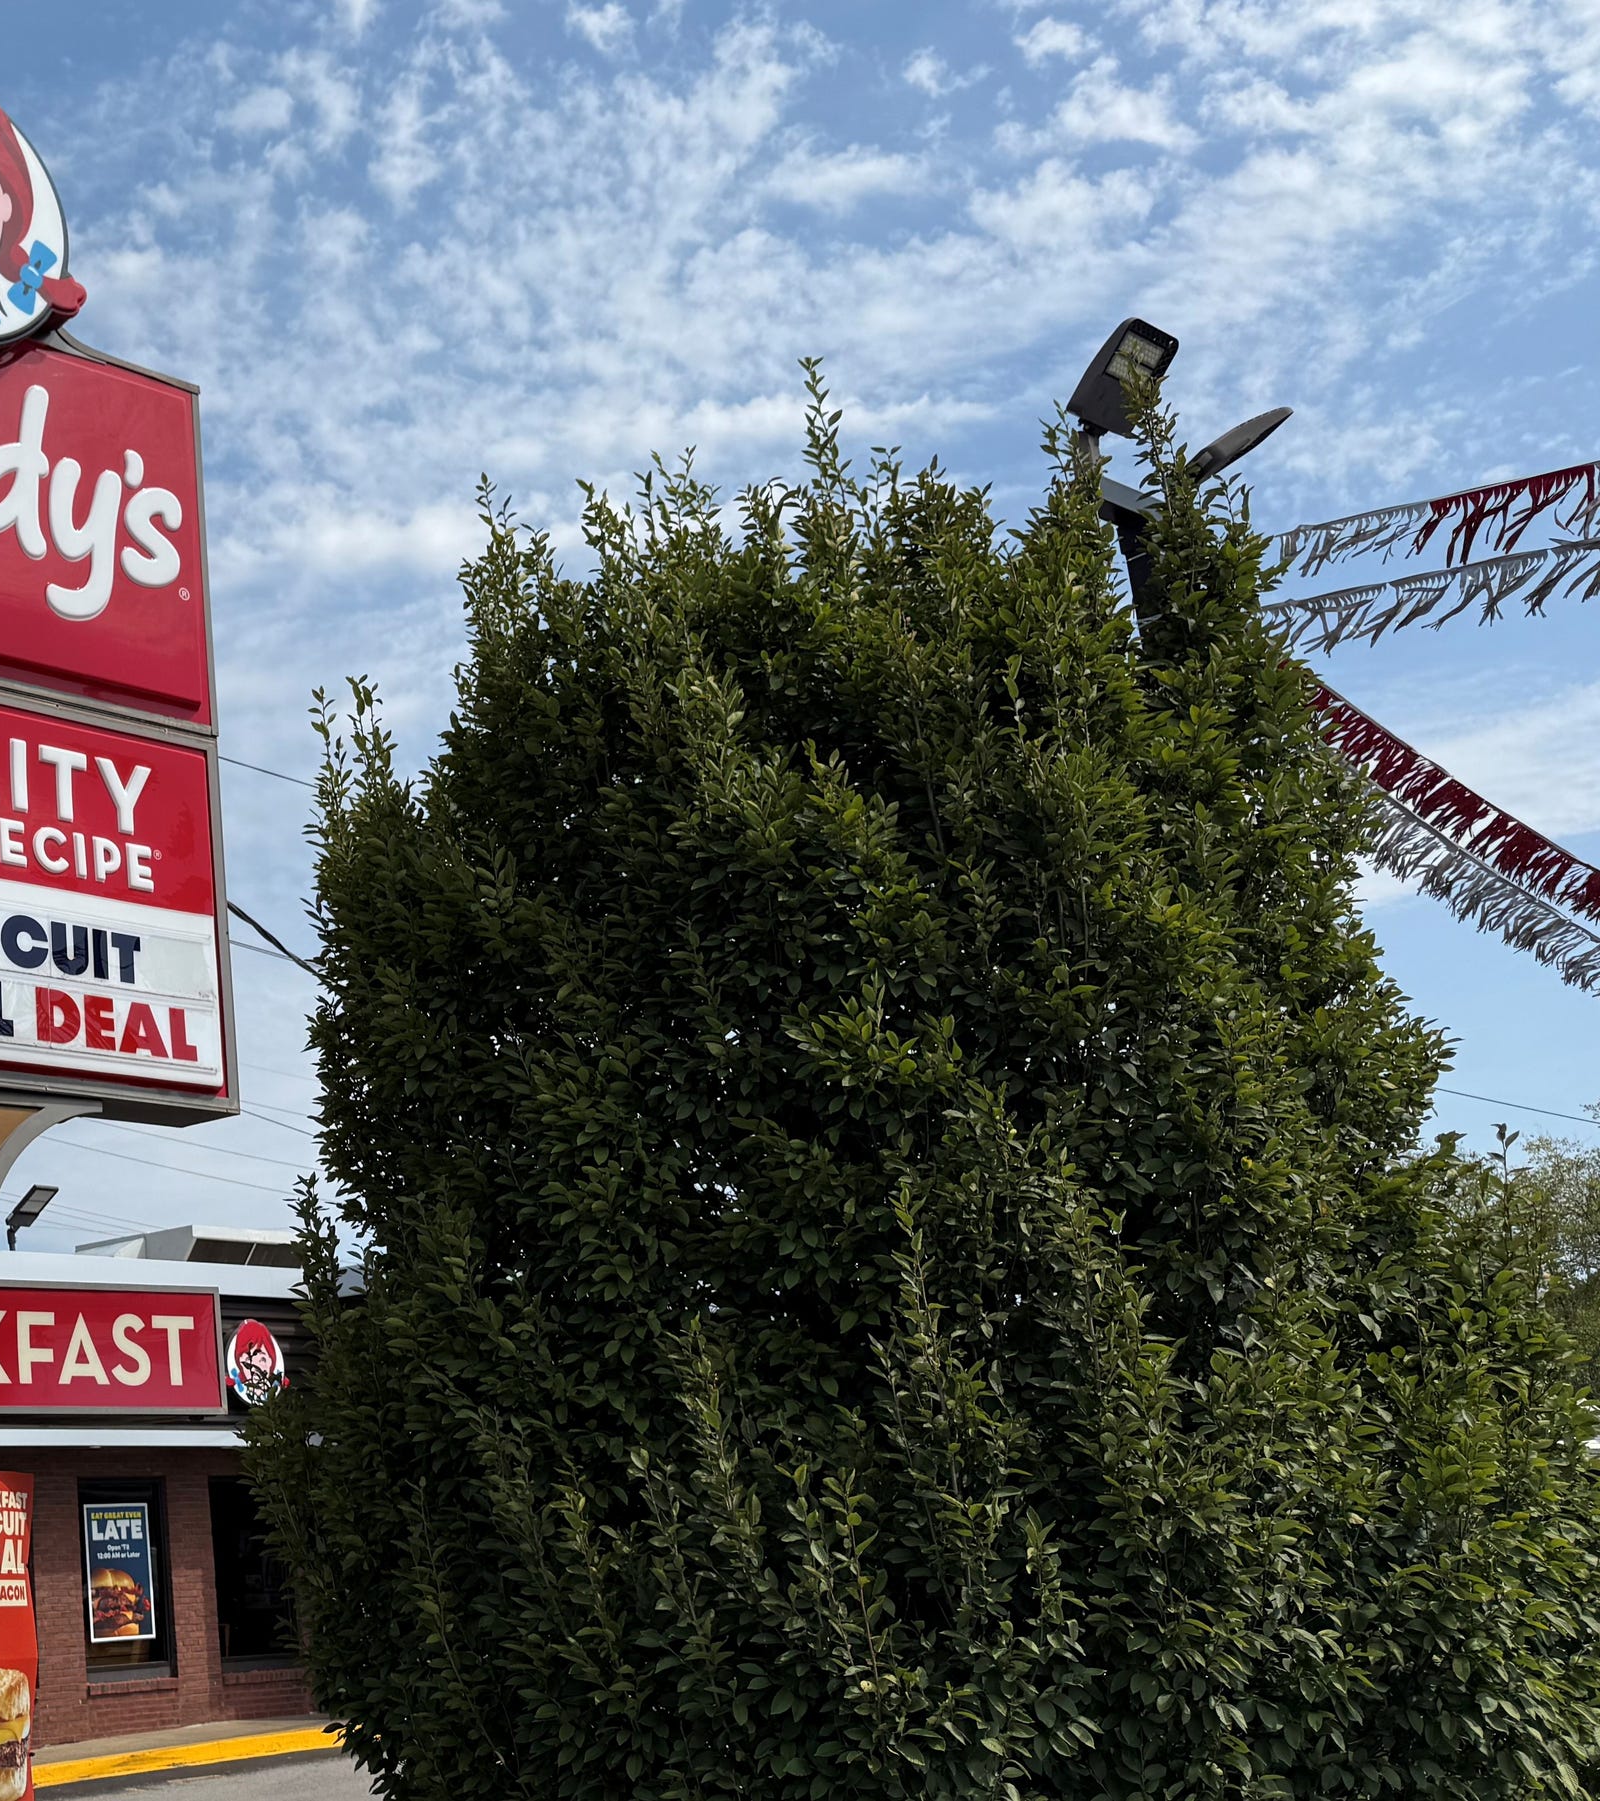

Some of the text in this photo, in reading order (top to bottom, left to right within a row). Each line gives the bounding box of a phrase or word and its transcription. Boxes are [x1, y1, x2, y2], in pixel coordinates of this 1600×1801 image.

[36, 986, 199, 1063] DEAL
[91, 1512, 103, 1520] EAT
[104, 1511, 124, 1519] GREAT
[91, 1519, 143, 1541] LATE
